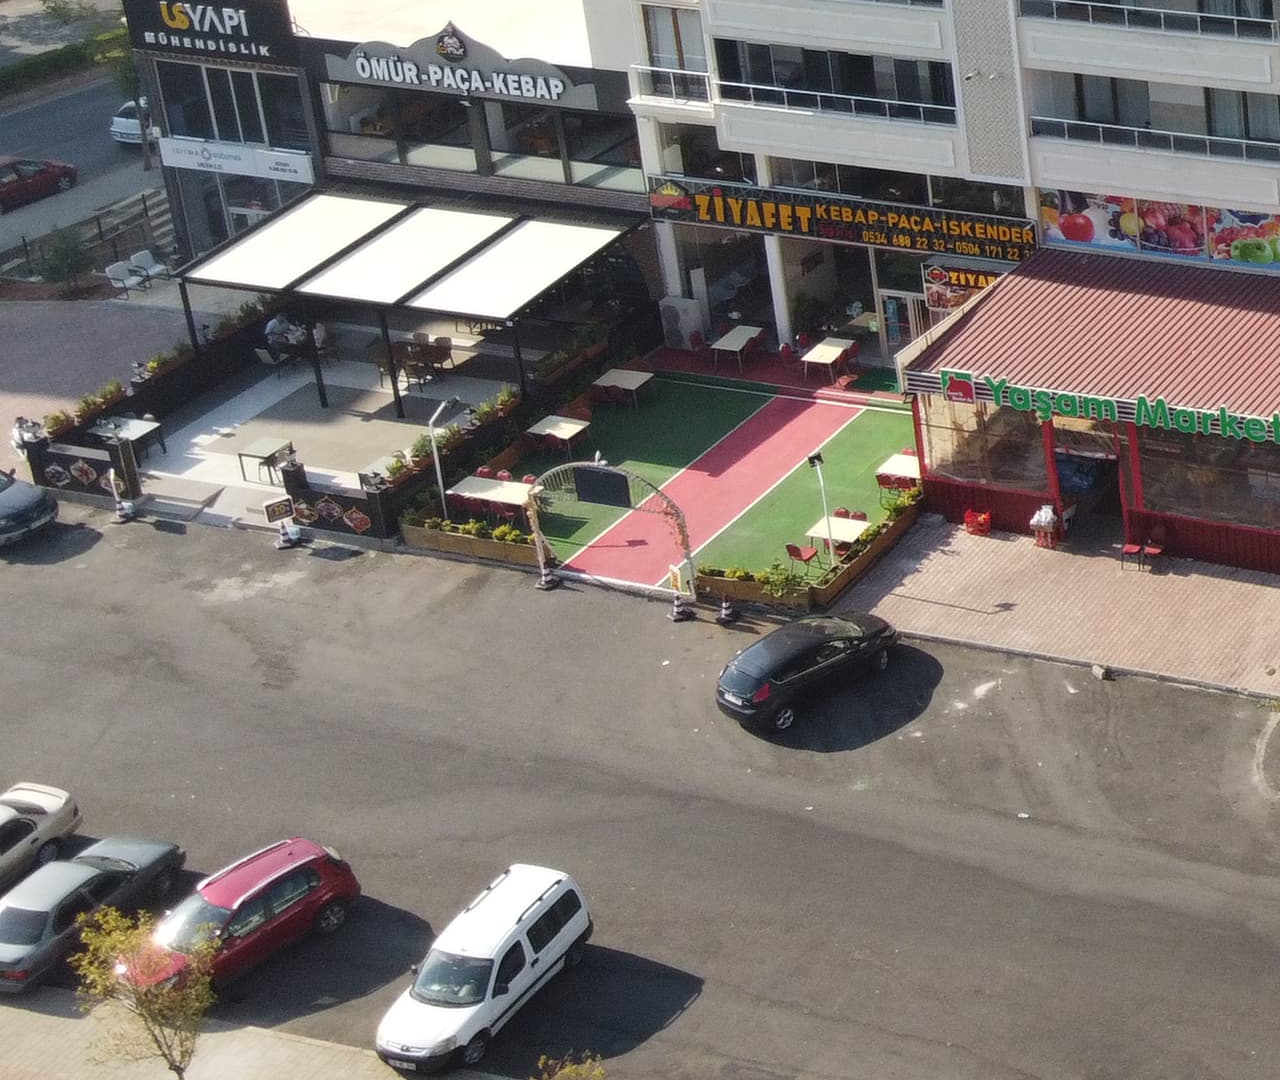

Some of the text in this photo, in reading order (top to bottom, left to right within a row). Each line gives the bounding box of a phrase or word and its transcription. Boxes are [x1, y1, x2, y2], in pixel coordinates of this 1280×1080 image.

[144, 31, 271, 57] MÜHENDİSLİK
[355, 52, 565, 100] ÖMÜR-PAÇA-KEBAP
[695, 187, 1034, 245] ZİYAFET KEBAP-PAÇA-İSKENDER
[862, 230, 887, 243] 0534
[916, 237, 928, 249] 22
[1007, 248, 1020, 261] 22
[949, 271, 1002, 288] ZİYAF
[984, 374, 1118, 422] Yaşam
